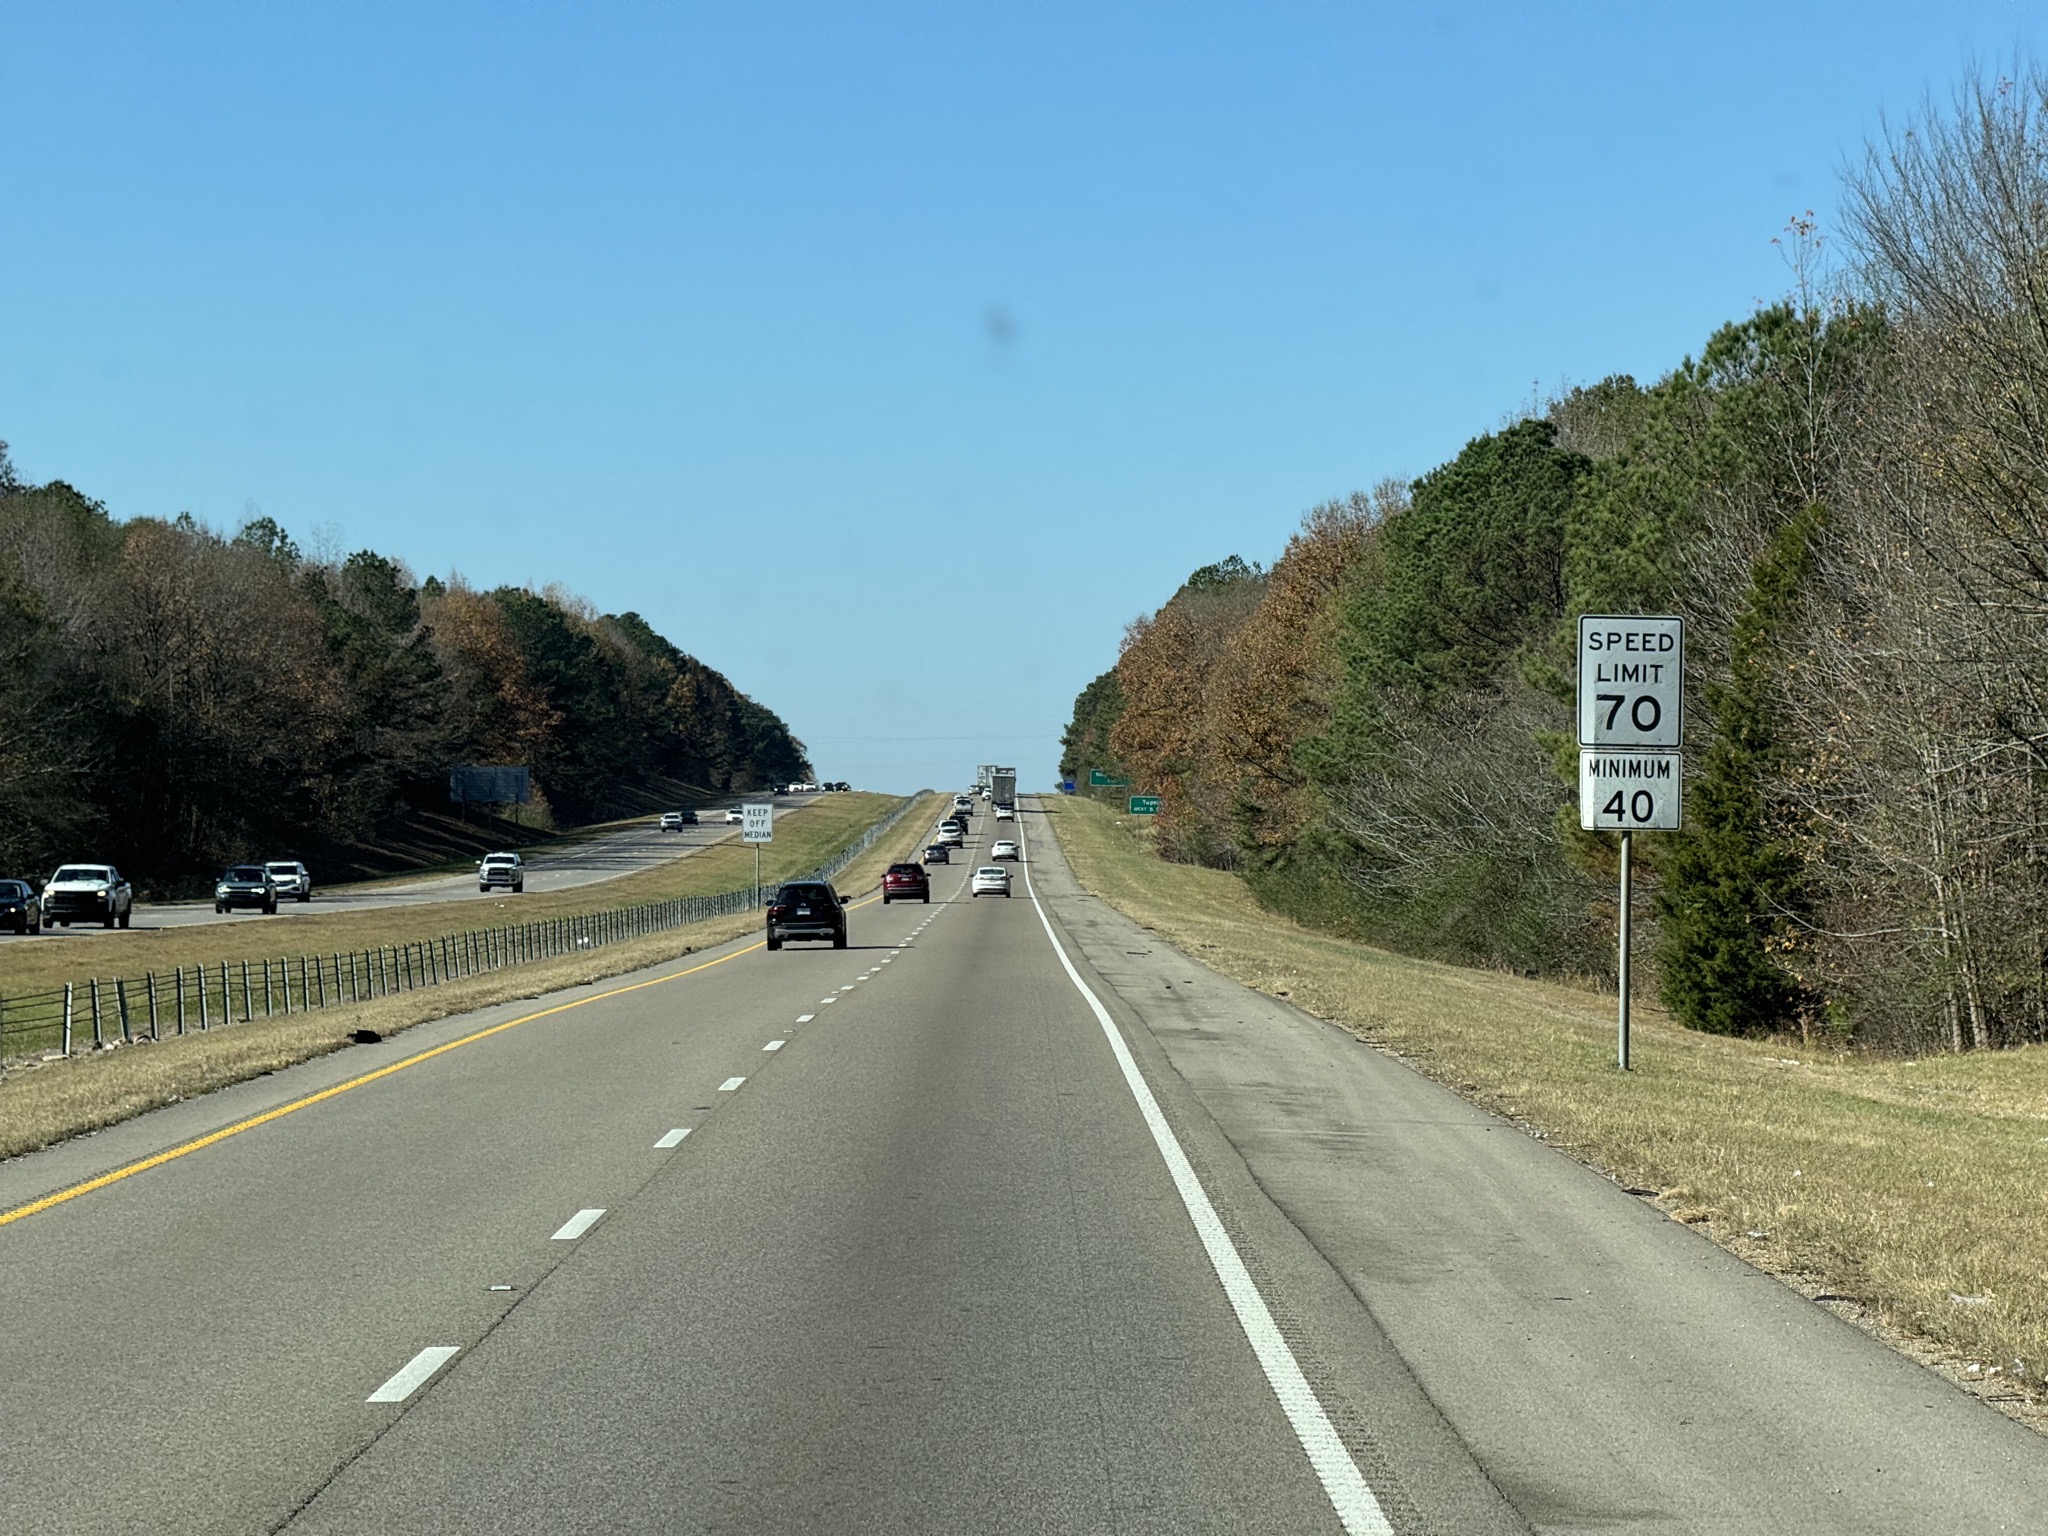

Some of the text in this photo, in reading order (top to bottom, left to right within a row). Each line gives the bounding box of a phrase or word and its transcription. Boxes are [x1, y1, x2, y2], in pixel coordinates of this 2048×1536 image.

[1588, 631, 1675, 652] SPEED
[1597, 663, 1664, 683] LIMIT
[1596, 694, 1662, 732] 70
[1589, 759, 1670, 779] MINIMUM
[747, 808, 768, 817] KEEP
[1602, 789, 1654, 823] 40
[749, 819, 766, 828] OFF
[744, 831, 772, 839] MEDIAN
